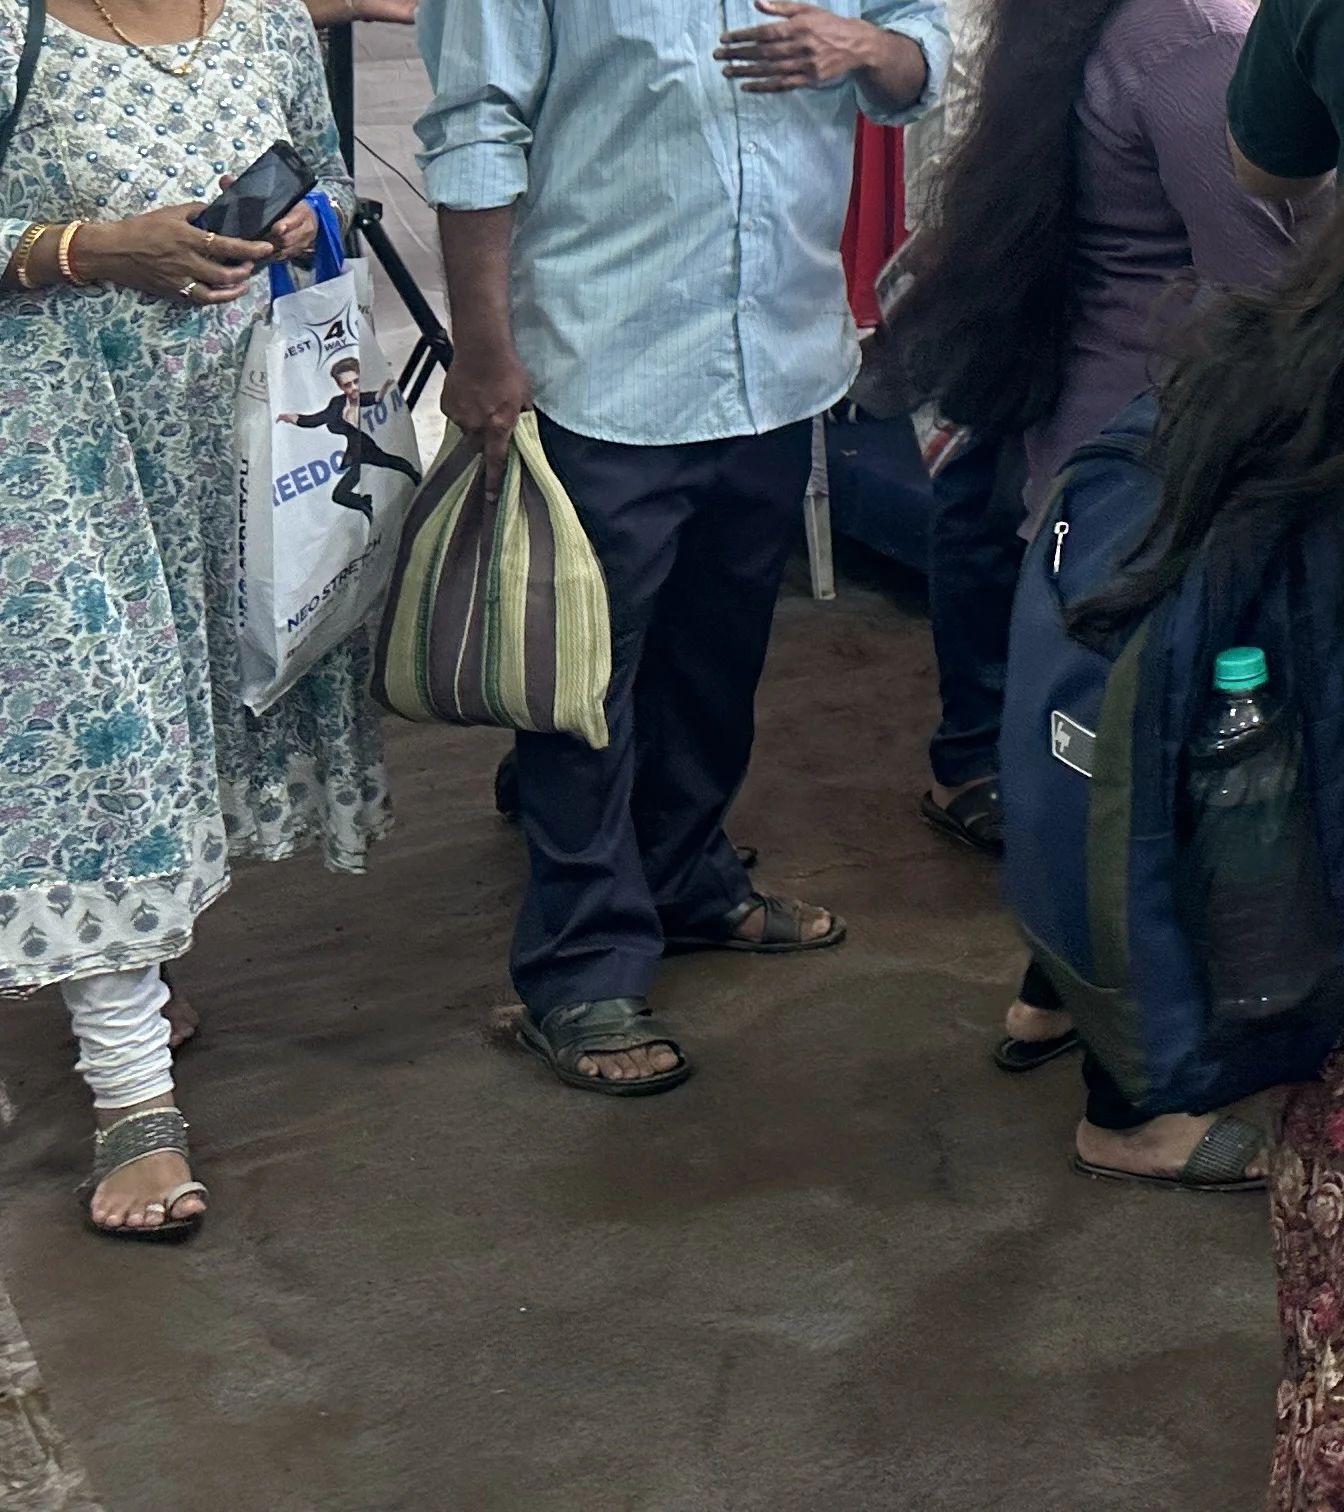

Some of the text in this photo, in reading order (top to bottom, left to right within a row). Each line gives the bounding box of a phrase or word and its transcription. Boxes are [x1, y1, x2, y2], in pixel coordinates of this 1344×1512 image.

[324, 320, 346, 341] 4
[324, 338, 347, 352] WAY
[362, 400, 388, 433] TO
[287, 595, 319, 633] NEO
